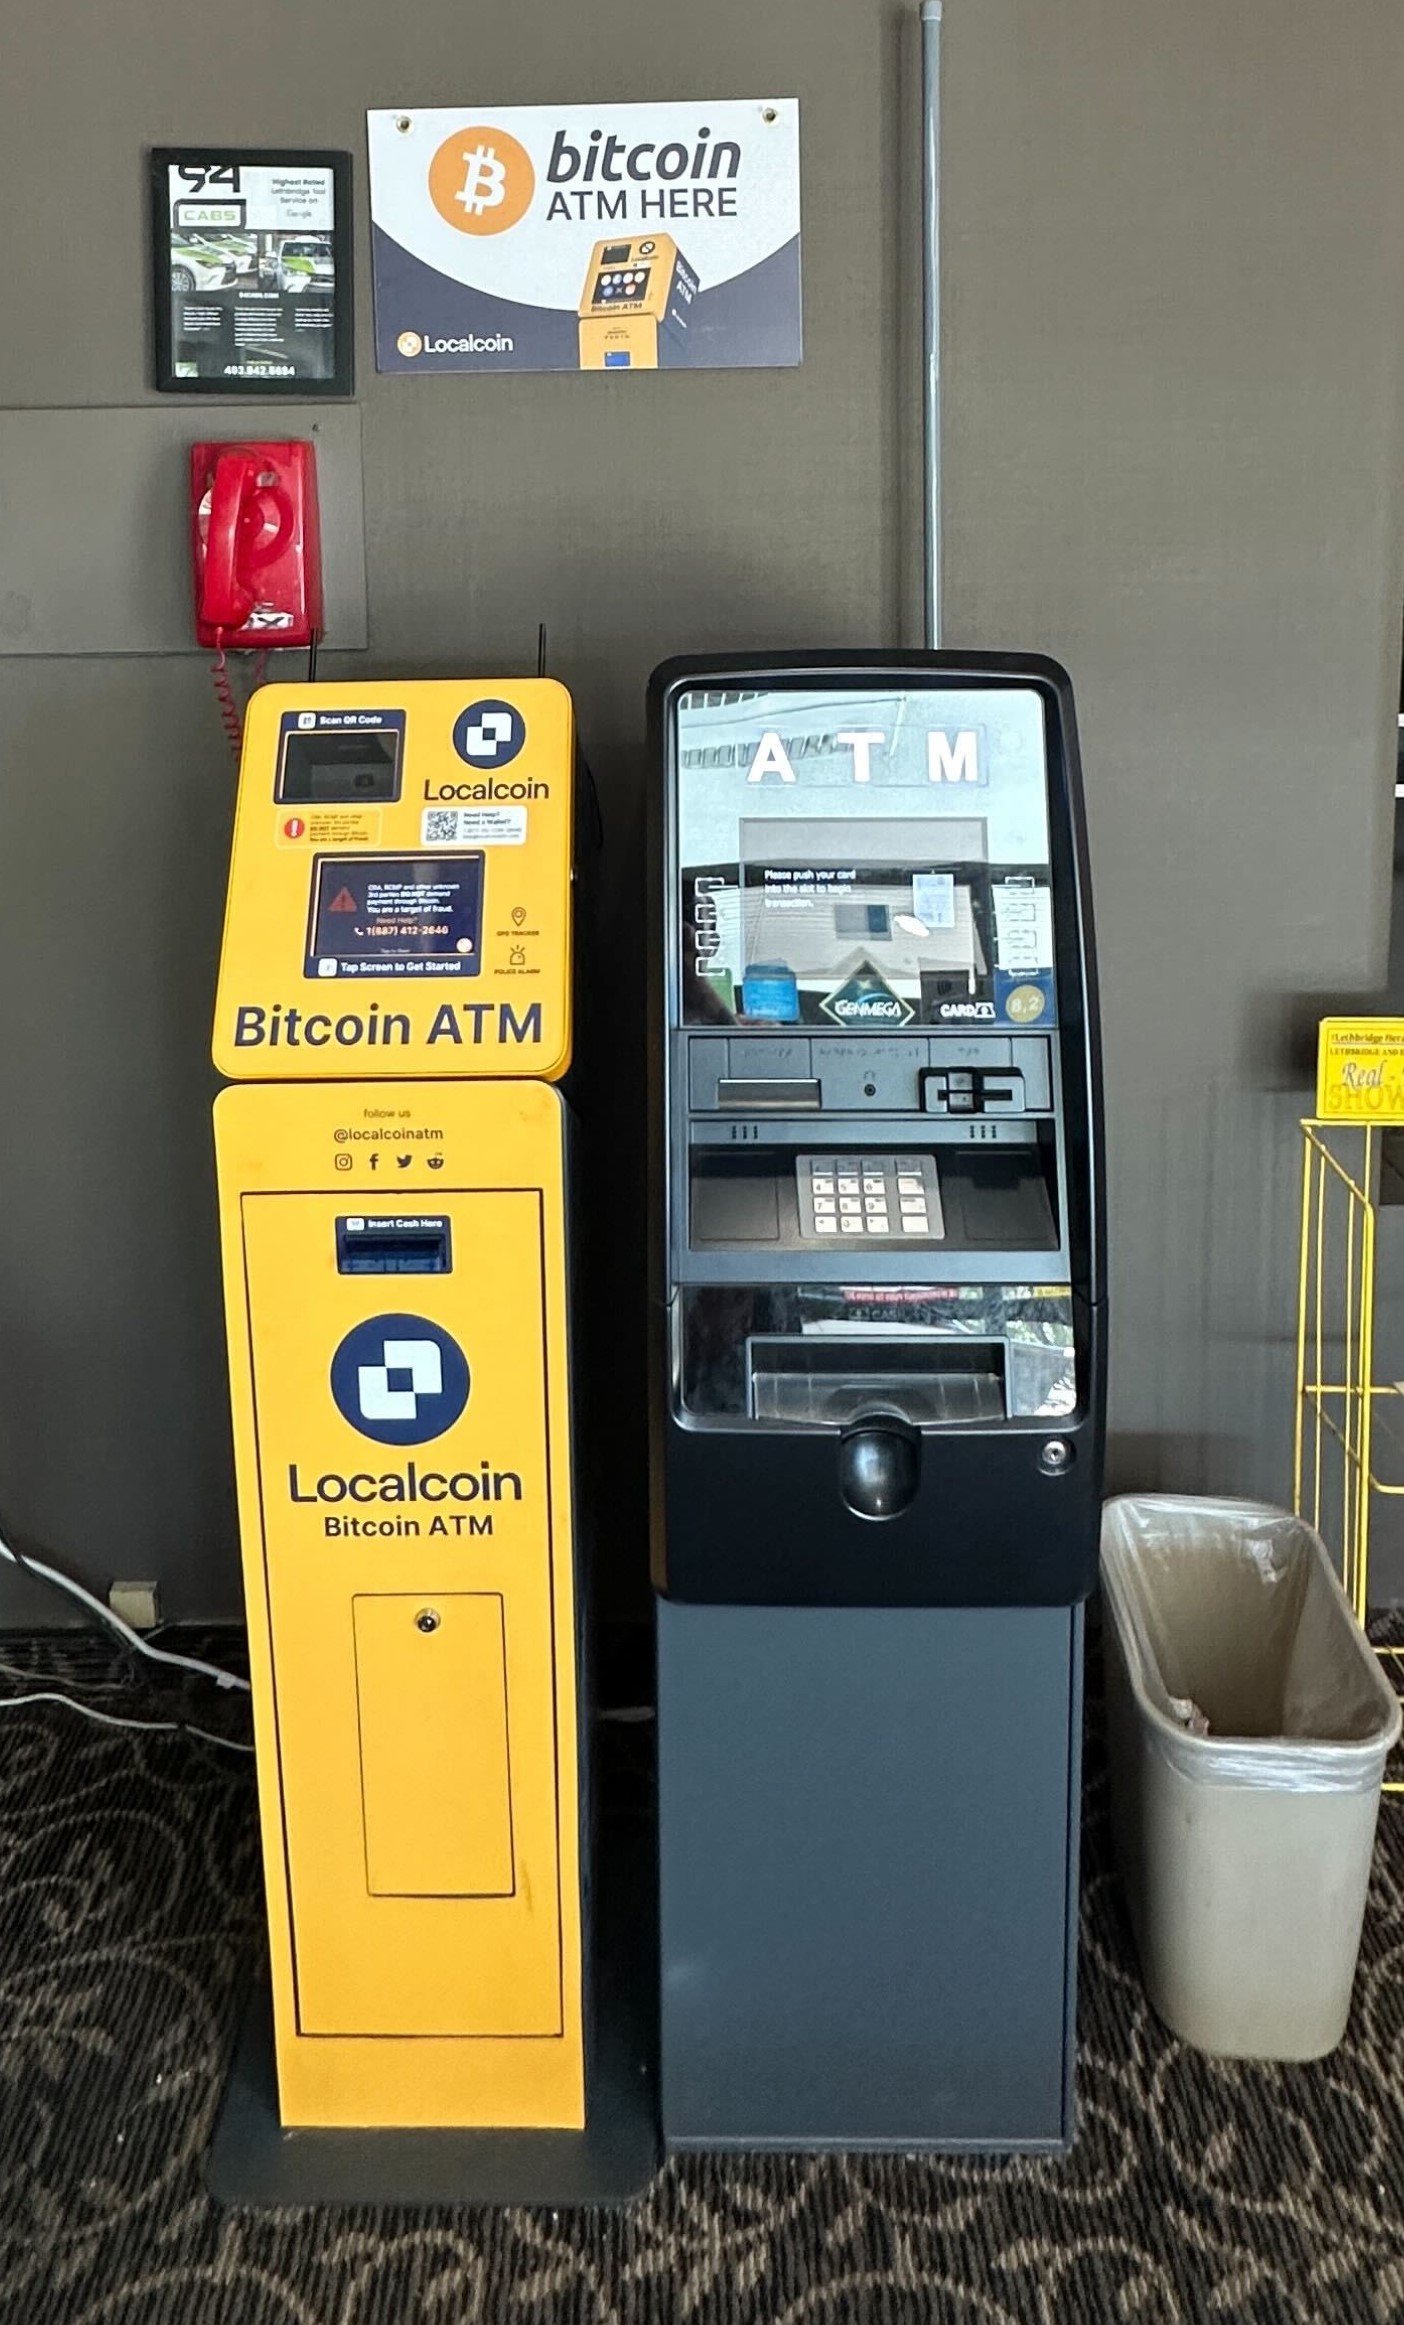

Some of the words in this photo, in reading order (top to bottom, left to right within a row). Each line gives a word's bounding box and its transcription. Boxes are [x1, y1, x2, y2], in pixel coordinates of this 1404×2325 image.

[547, 127, 741, 182] bitcoin
[546, 190, 628, 220] ATM
[642, 187, 738, 218] HERE
[184, 210, 236, 220] CABS
[425, 333, 514, 354] Localcoin
[320, 716, 342, 725] Scan
[343, 716, 357, 724] QR
[358, 715, 382, 724] Code
[424, 777, 549, 801] Localcoin
[764, 869, 792, 879] Please
[793, 869, 814, 881] push
[816, 871, 835, 881] your
[837, 869, 856, 879] card
[764, 884, 782, 893] into
[783, 884, 798, 893] the
[799, 884, 815, 893] slot
[816, 884, 826, 893] to
[827, 883, 852, 895] begin
[401, 906, 422, 914] target
[341, 962, 358, 974] Tap
[360, 961, 393, 972] Screen
[395, 961, 405, 971] to
[407, 961, 424, 971] Get
[426, 960, 461, 971] Started
[834, 1000, 901, 1017] GENMEGA
[234, 1002, 410, 1047] Bitcoin
[426, 1002, 542, 1045] ATM
[1342, 1060, 1388, 1091] Real
[364, 1108, 395, 1119] follow
[397, 1109, 411, 1118] us
[333, 1127, 444, 1144] @localcoinatm
[368, 1219, 395, 1228] Insert
[396, 1219, 420, 1228] Cash
[421, 1219, 443, 1228] Here
[288, 1460, 522, 1503] Localcoin
[324, 1515, 420, 1537] Bitcoin
[428, 1515, 493, 1536] ATM
